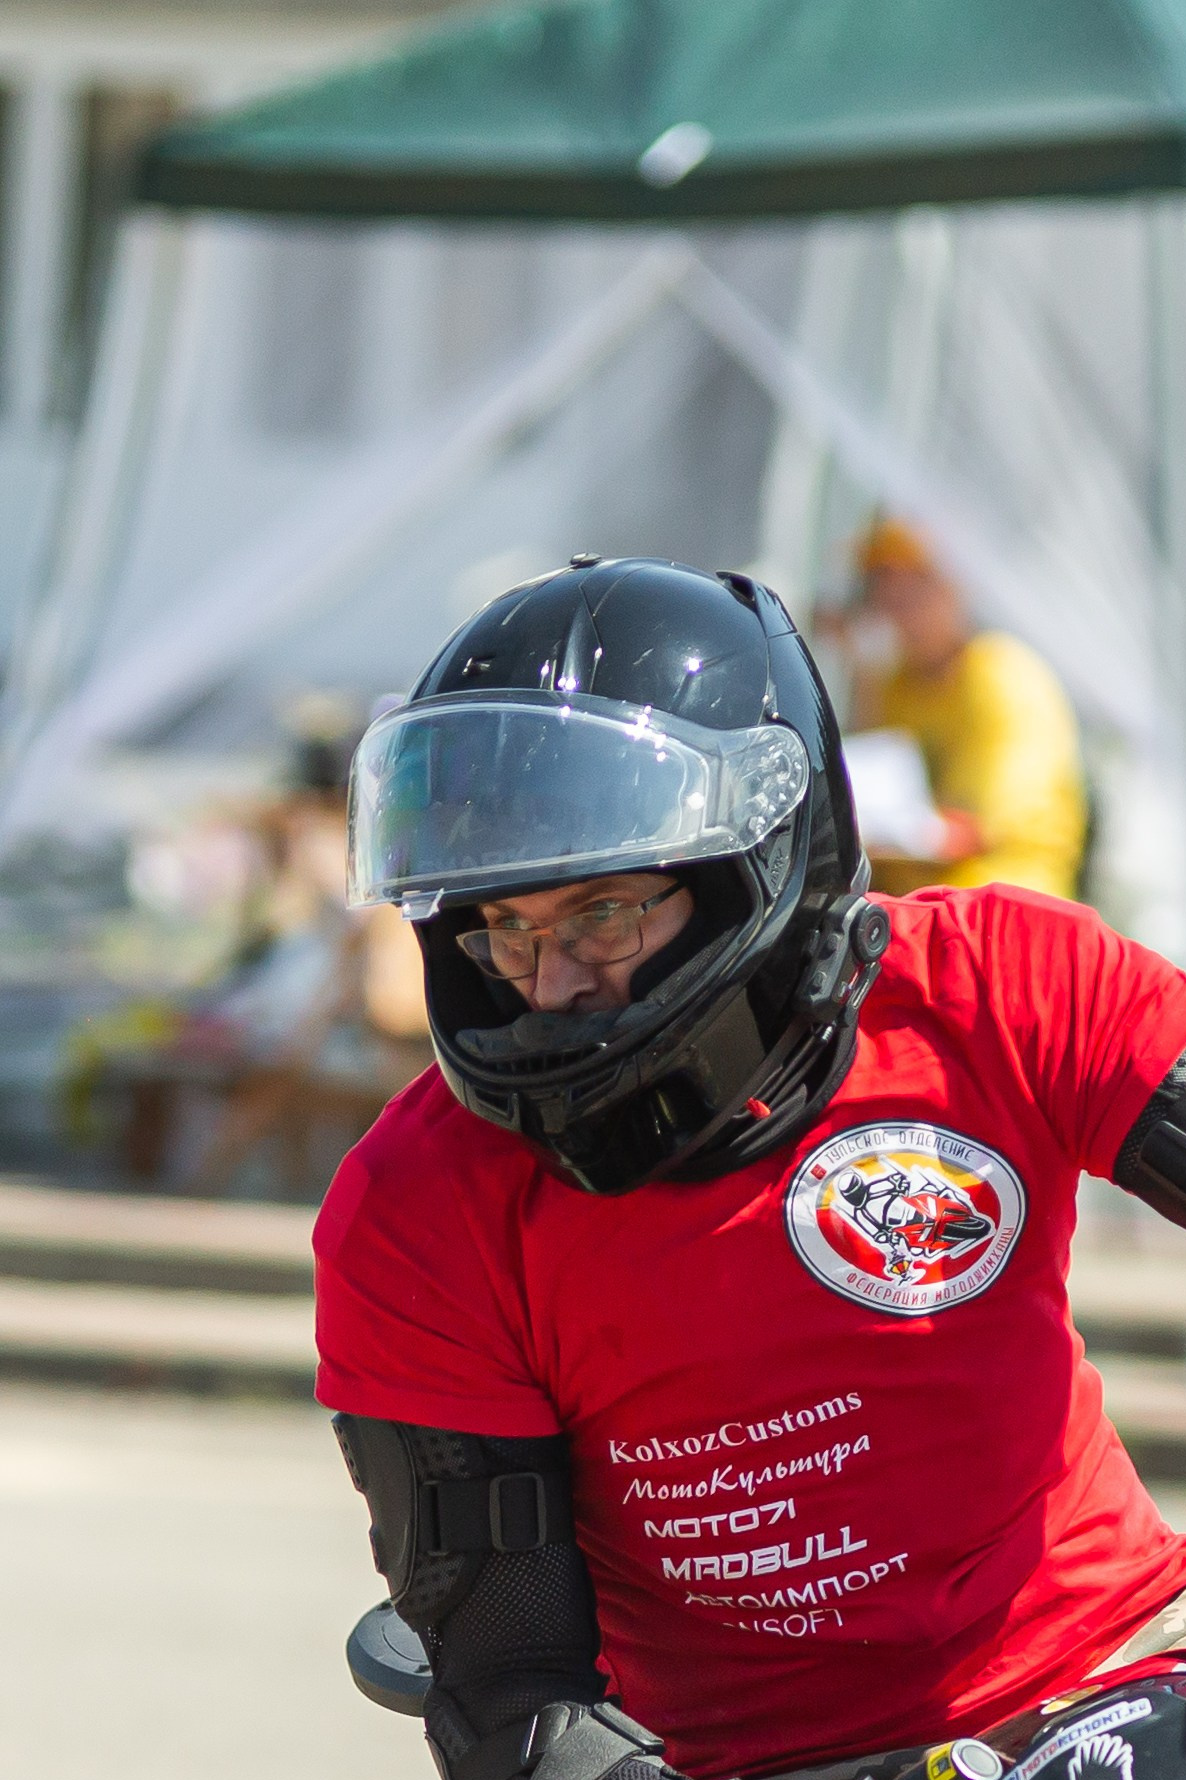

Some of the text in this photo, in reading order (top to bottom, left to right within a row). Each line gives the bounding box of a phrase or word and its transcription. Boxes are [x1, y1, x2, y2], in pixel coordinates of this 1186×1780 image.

[825, 1130, 975, 1164] ТУЛЬСКОЕ ОТДЕЛЕНИЕ
[846, 1272, 928, 1306] ФЕДЕРАЦИЯ
[608, 1391, 863, 1465] KolxozCustoms
[622, 1434, 871, 1505] МотоКультура
[661, 1525, 868, 1582] MADBULL
